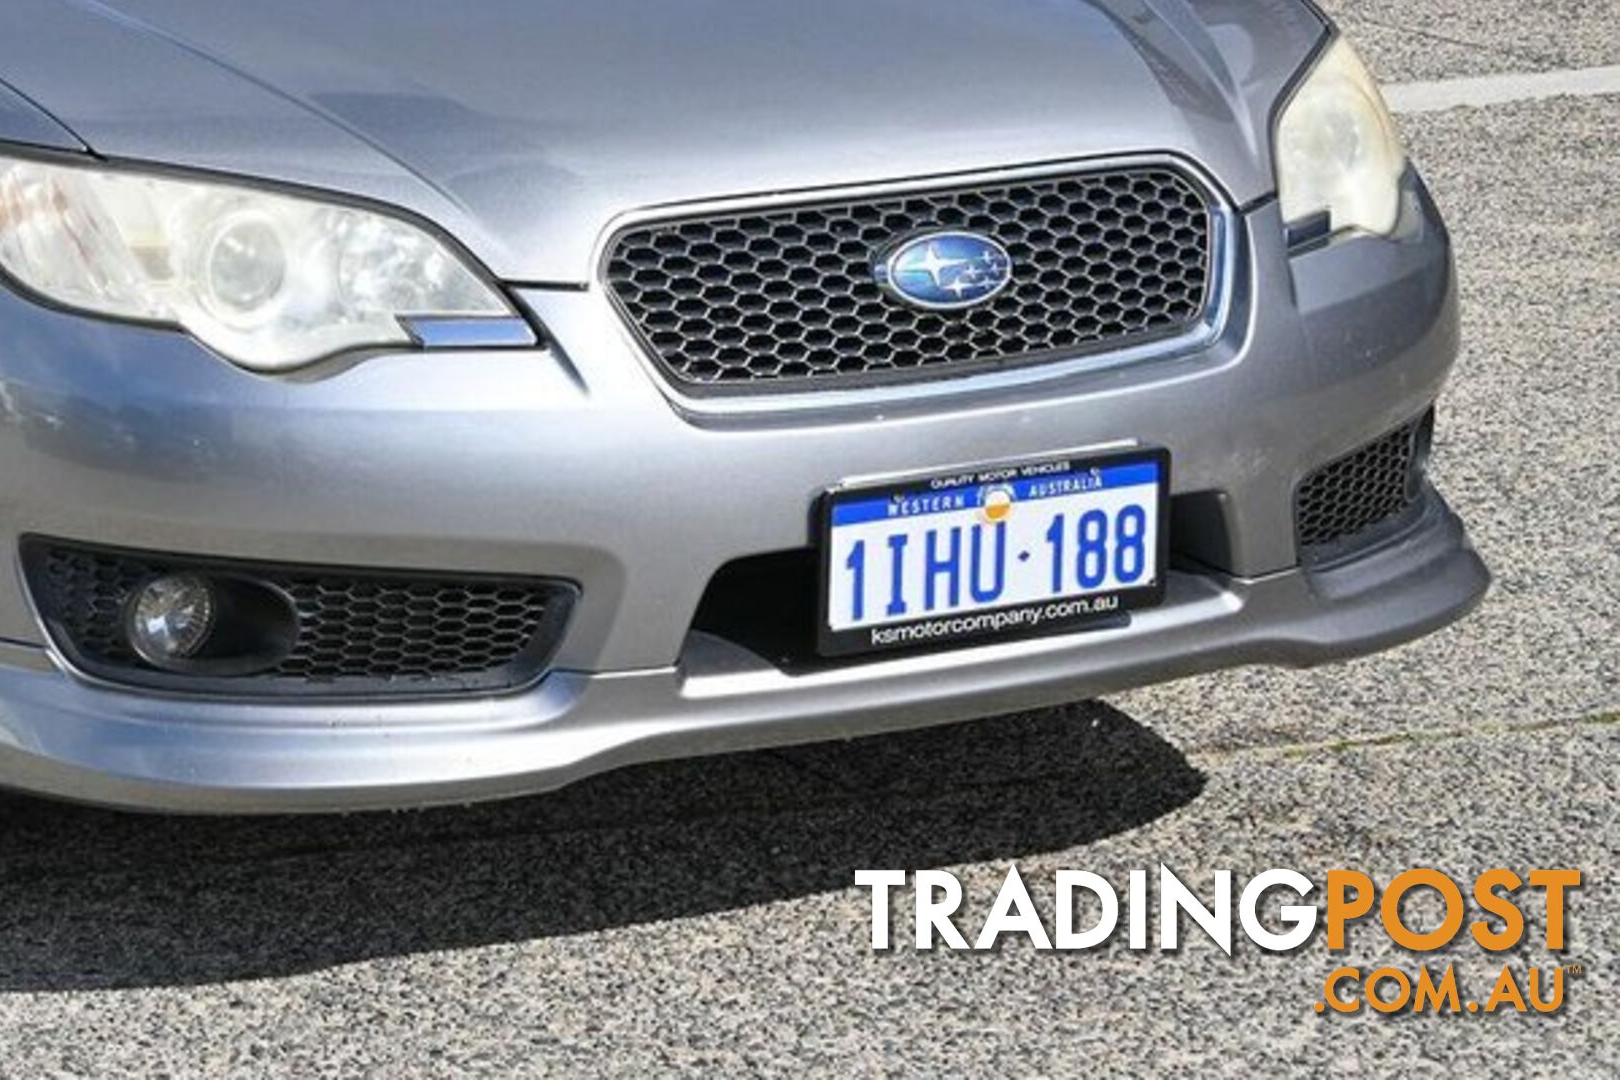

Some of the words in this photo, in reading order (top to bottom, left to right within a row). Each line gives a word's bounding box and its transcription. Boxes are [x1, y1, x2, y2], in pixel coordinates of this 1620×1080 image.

[888, 494, 964, 517] WESTERN
[1028, 474, 1102, 498] AUSTRALIA
[978, 468, 1018, 483] MOTOR
[871, 595, 1119, 646] ksmotorcompany.com.au
